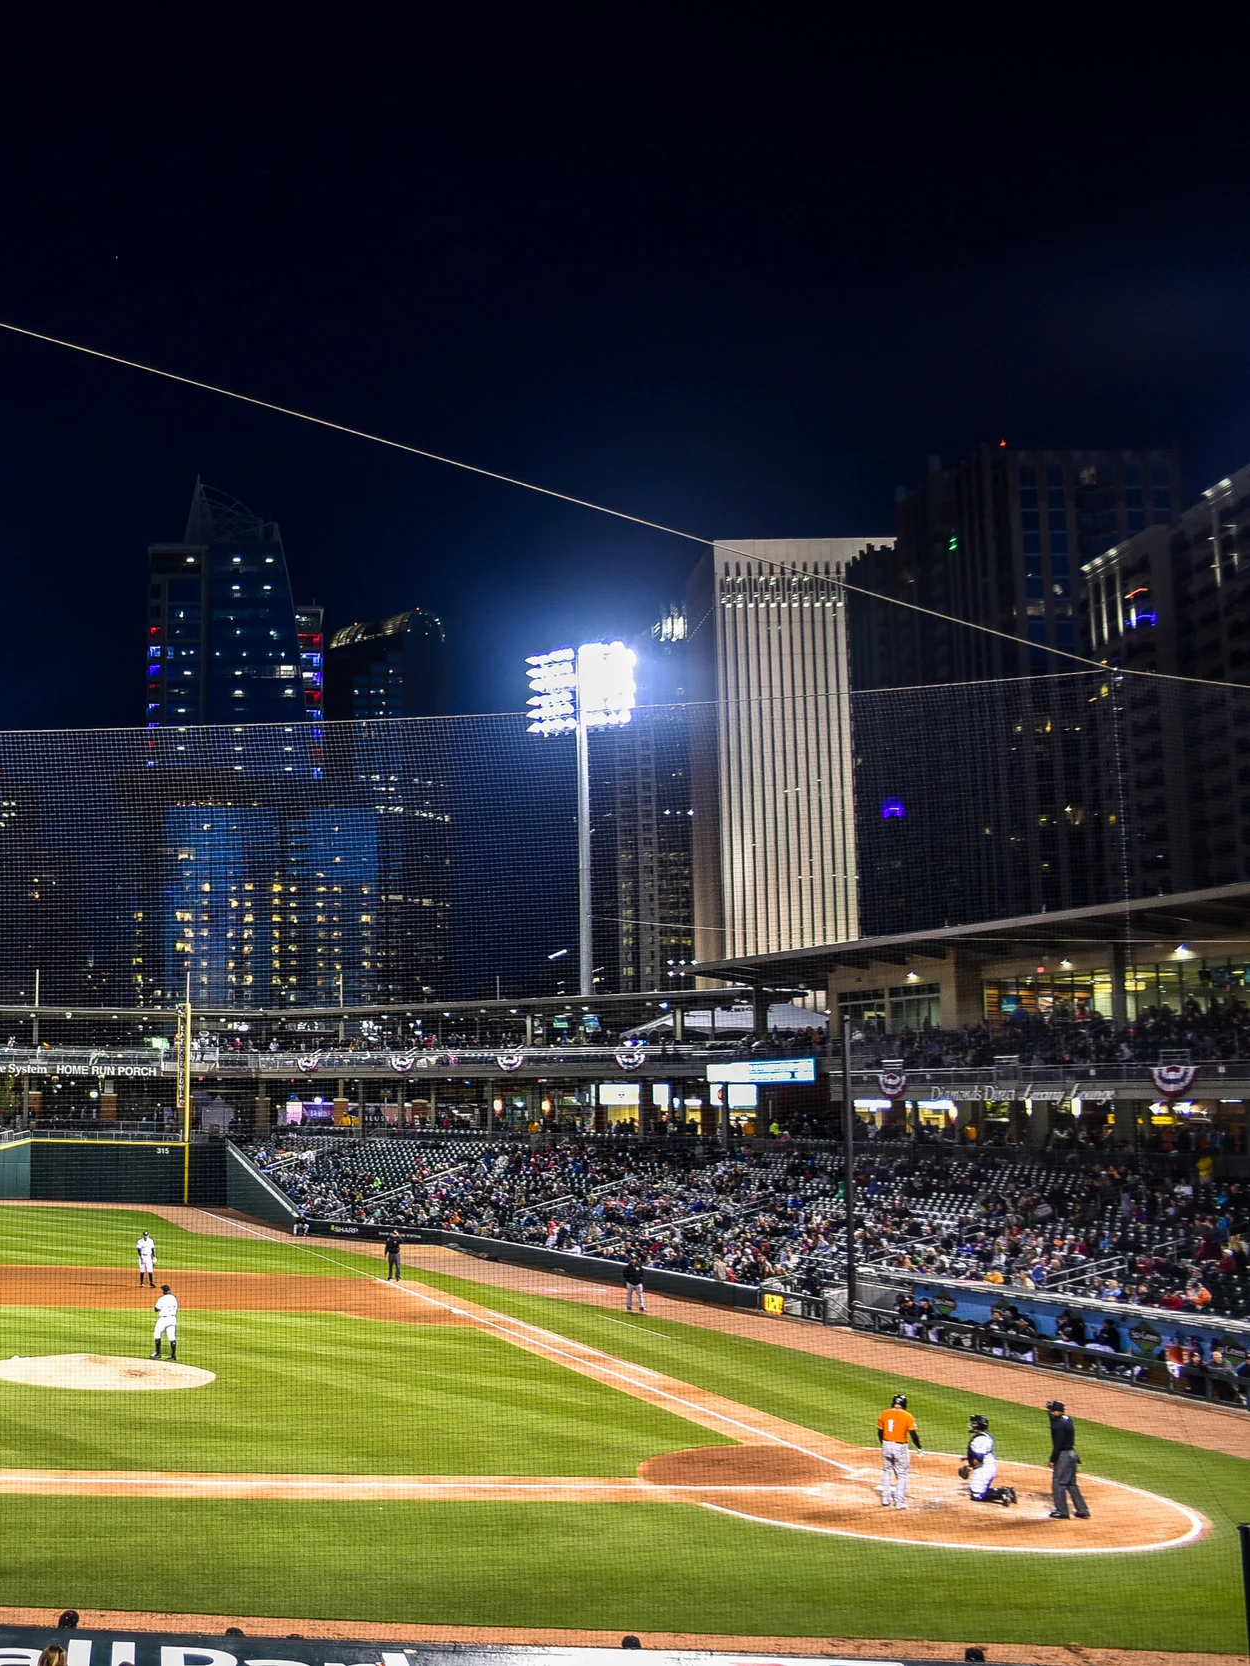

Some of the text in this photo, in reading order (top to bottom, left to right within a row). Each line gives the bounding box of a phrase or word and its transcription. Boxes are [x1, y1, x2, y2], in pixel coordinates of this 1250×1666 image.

[7, 1064, 48, 1077] System
[56, 1065, 89, 1075] HOME
[91, 1066, 115, 1075] RUN
[117, 1066, 157, 1076] PORCH
[334, 1226, 358, 1234] SHARP
[887, 1419, 895, 1433] 1
